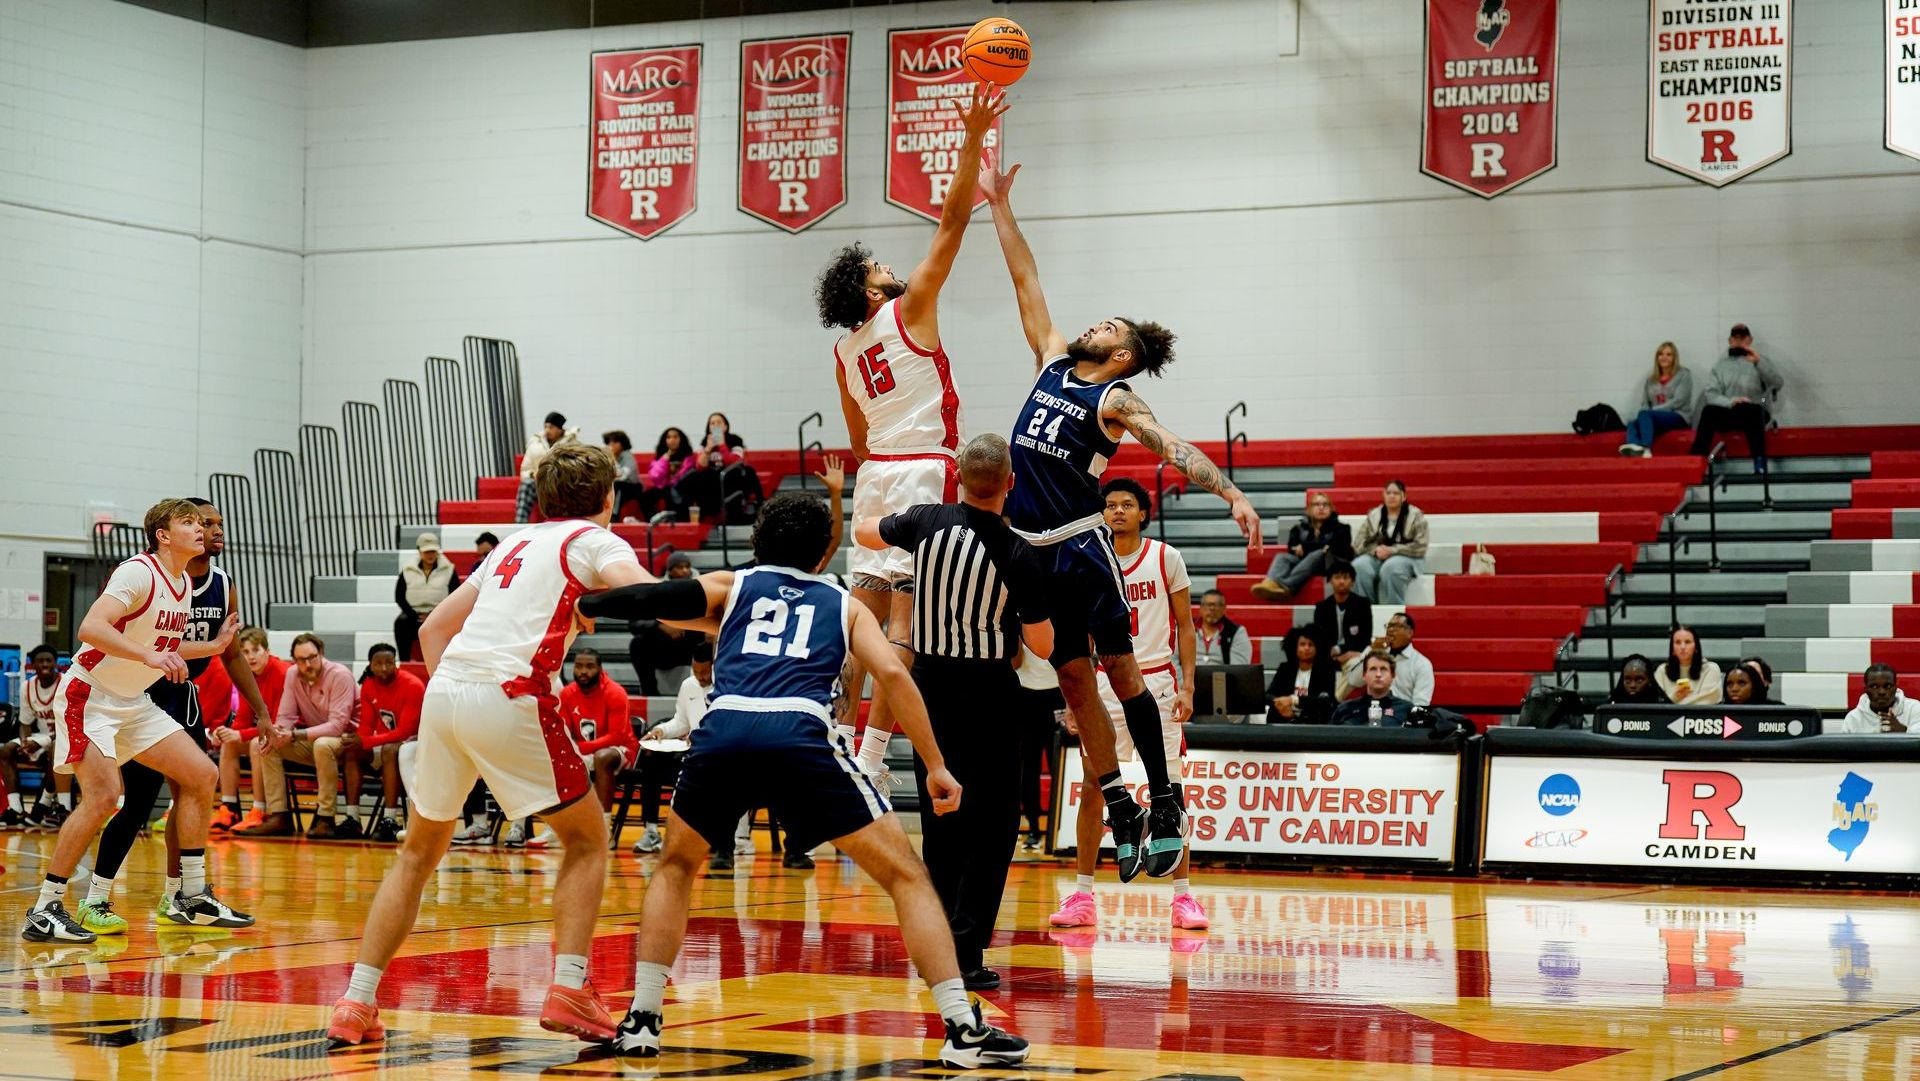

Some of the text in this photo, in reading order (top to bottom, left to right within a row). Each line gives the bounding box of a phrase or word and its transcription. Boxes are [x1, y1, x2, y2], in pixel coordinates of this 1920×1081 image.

[1662, 5, 1779, 26] DIVISION III
[1658, 27, 1784, 52] SOFTBALL
[900, 46, 963, 73] MAR
[987, 45, 1029, 61] Wilson
[1660, 55, 1781, 73] EAST REGIONAL
[602, 65, 683, 92] MARC
[753, 54, 830, 82] MARC
[1445, 56, 1538, 79] SOFTBALL
[1433, 82, 1550, 108] CHAMPIONS
[1660, 75, 1781, 97] CHAMPIONS
[618, 101, 675, 117] WOMEN'S
[1687, 100, 1753, 124] 2006
[598, 114, 694, 135] ROWING PAIR
[1462, 112, 1518, 135] 2004
[747, 137, 838, 161] CHAMPIONS
[896, 128, 998, 153] CHAMPIS
[1701, 130, 1738, 163] R
[598, 147, 693, 169] CHAMPIONS
[920, 151, 960, 173] 201
[1470, 142, 1507, 178] R
[619, 167, 673, 190] 2009
[768, 159, 820, 181] 2010
[630, 190, 660, 220] R
[778, 182, 810, 212] R
[857, 342, 896, 400] 15
[1027, 408, 1065, 443] 24
[1037, 441, 1070, 460] VALLEY
[493, 540, 532, 589] 4
[195, 607, 222, 619] STATE
[741, 596, 815, 660] 21
[1623, 720, 1650, 731] BONUS
[1684, 718, 1723, 735] POSS
[1758, 721, 1786, 733] BONUS
[1306, 763, 1340, 782] TO
[1239, 786, 1445, 816] UNIVERSITY
[1541, 794, 1580, 807] NCAA
[1659, 769, 1745, 840] R
[1225, 816, 1270, 843] AT
[1279, 817, 1428, 848] CAMDEN
[1535, 831, 1577, 848] ECAC
[1645, 844, 1756, 861] CAMDEN
